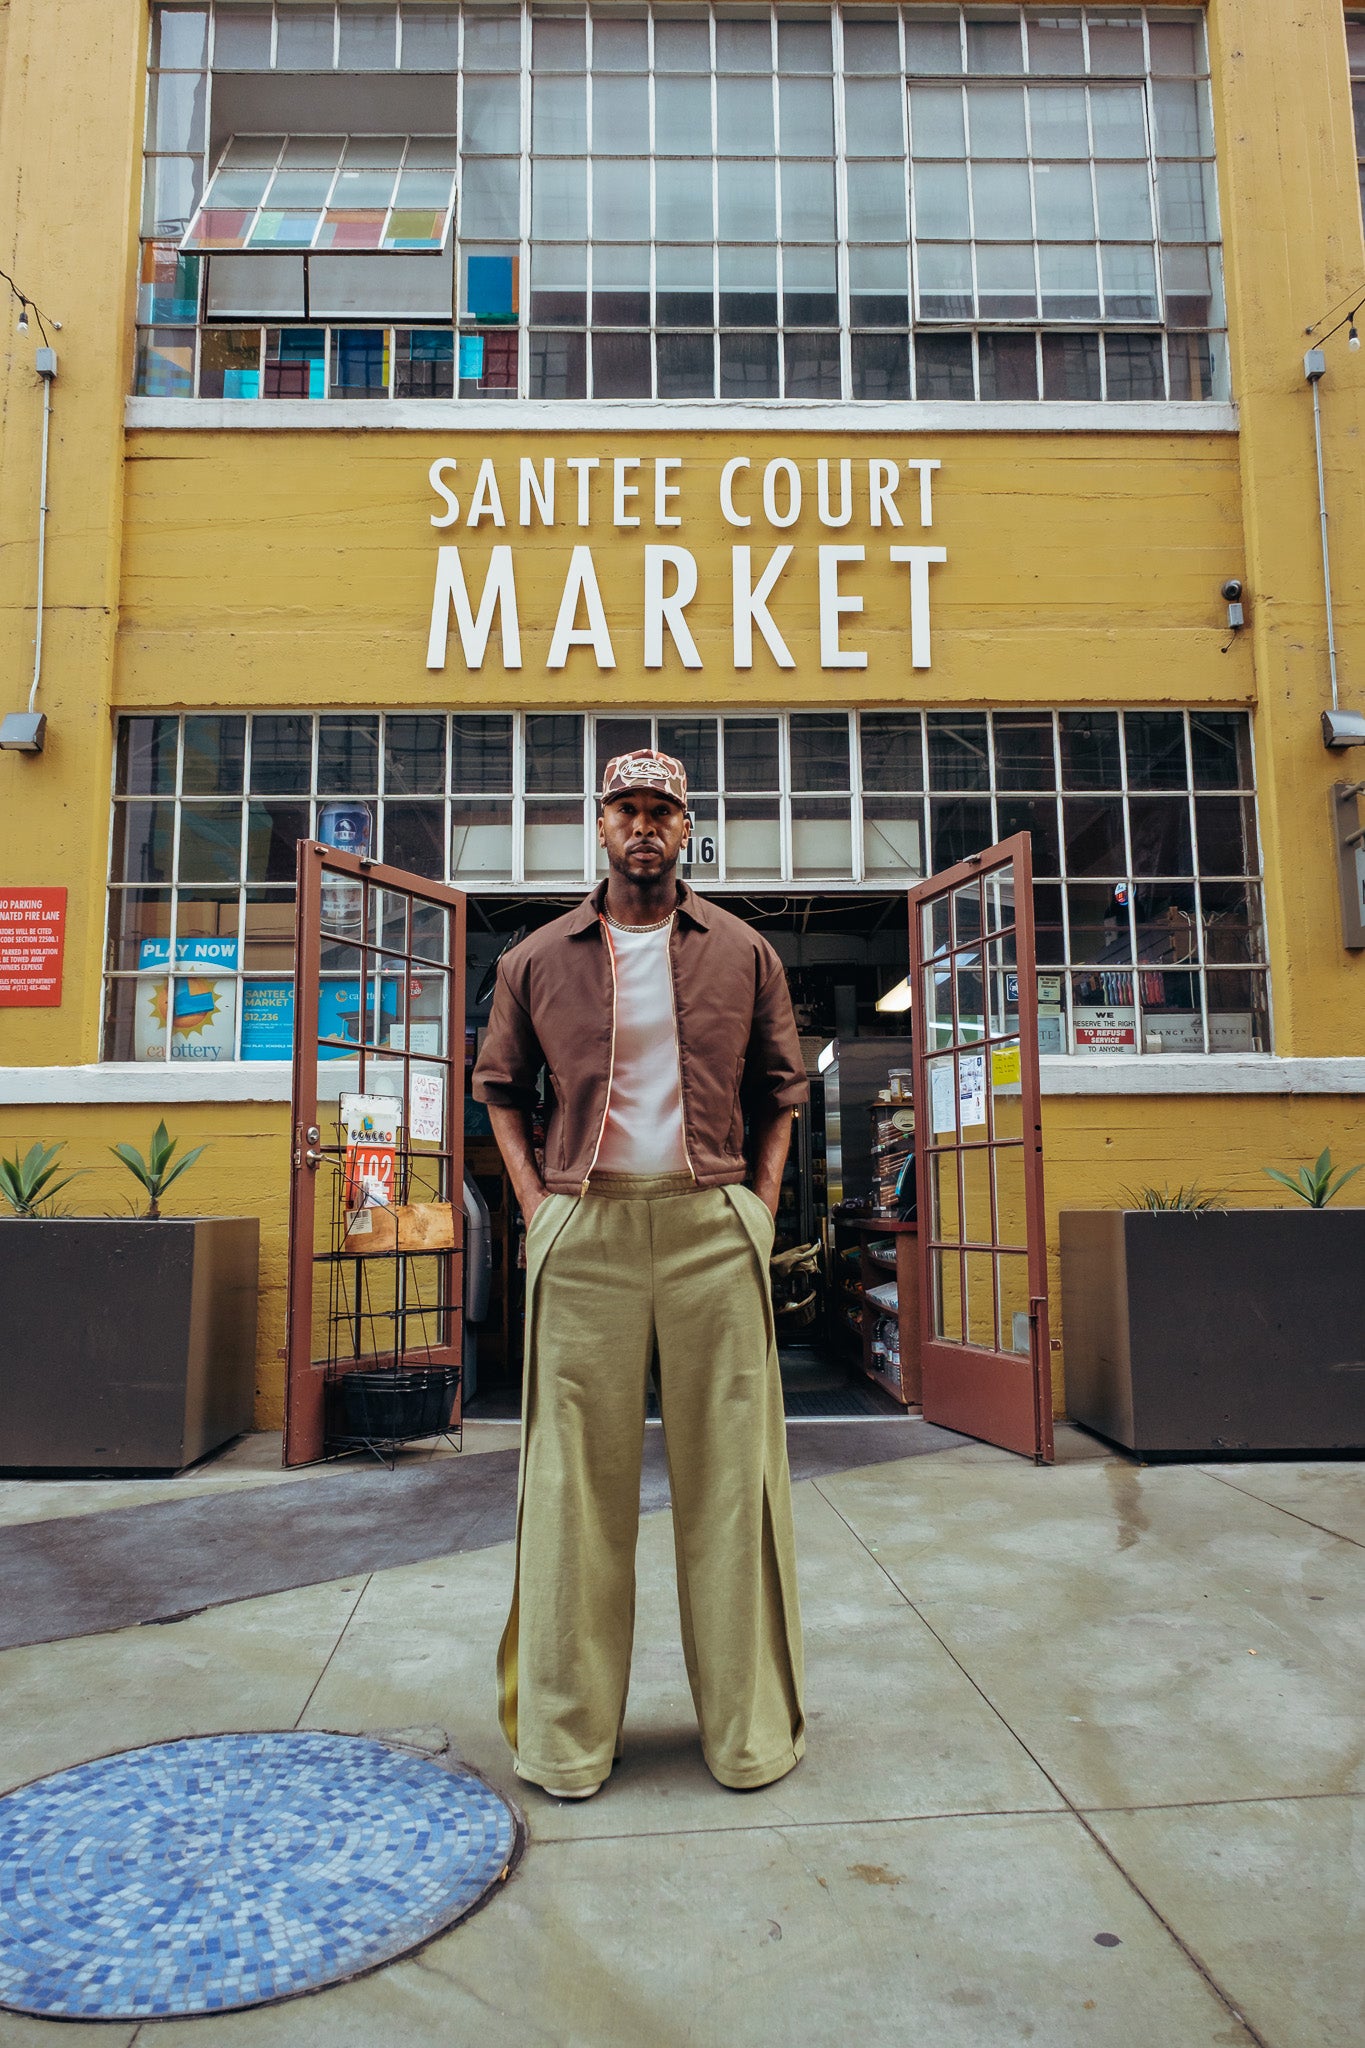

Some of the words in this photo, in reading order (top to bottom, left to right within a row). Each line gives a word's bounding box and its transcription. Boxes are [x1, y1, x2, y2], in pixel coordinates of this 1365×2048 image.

[427, 456, 684, 530] SANTEE
[719, 456, 943, 530] COURT
[426, 543, 949, 670] MARKET
[10, 900, 42, 909] PARKING
[25, 912, 40, 920] FIRE
[42, 912, 60, 920] LANE
[143, 944, 188, 957] PLAY
[195, 944, 236, 957] NOW
[245, 990, 285, 998] SANTEE
[245, 998, 288, 1007] MARKET
[244, 1013, 279, 1021] $12,236
[147, 1043, 221, 1061] caottery
